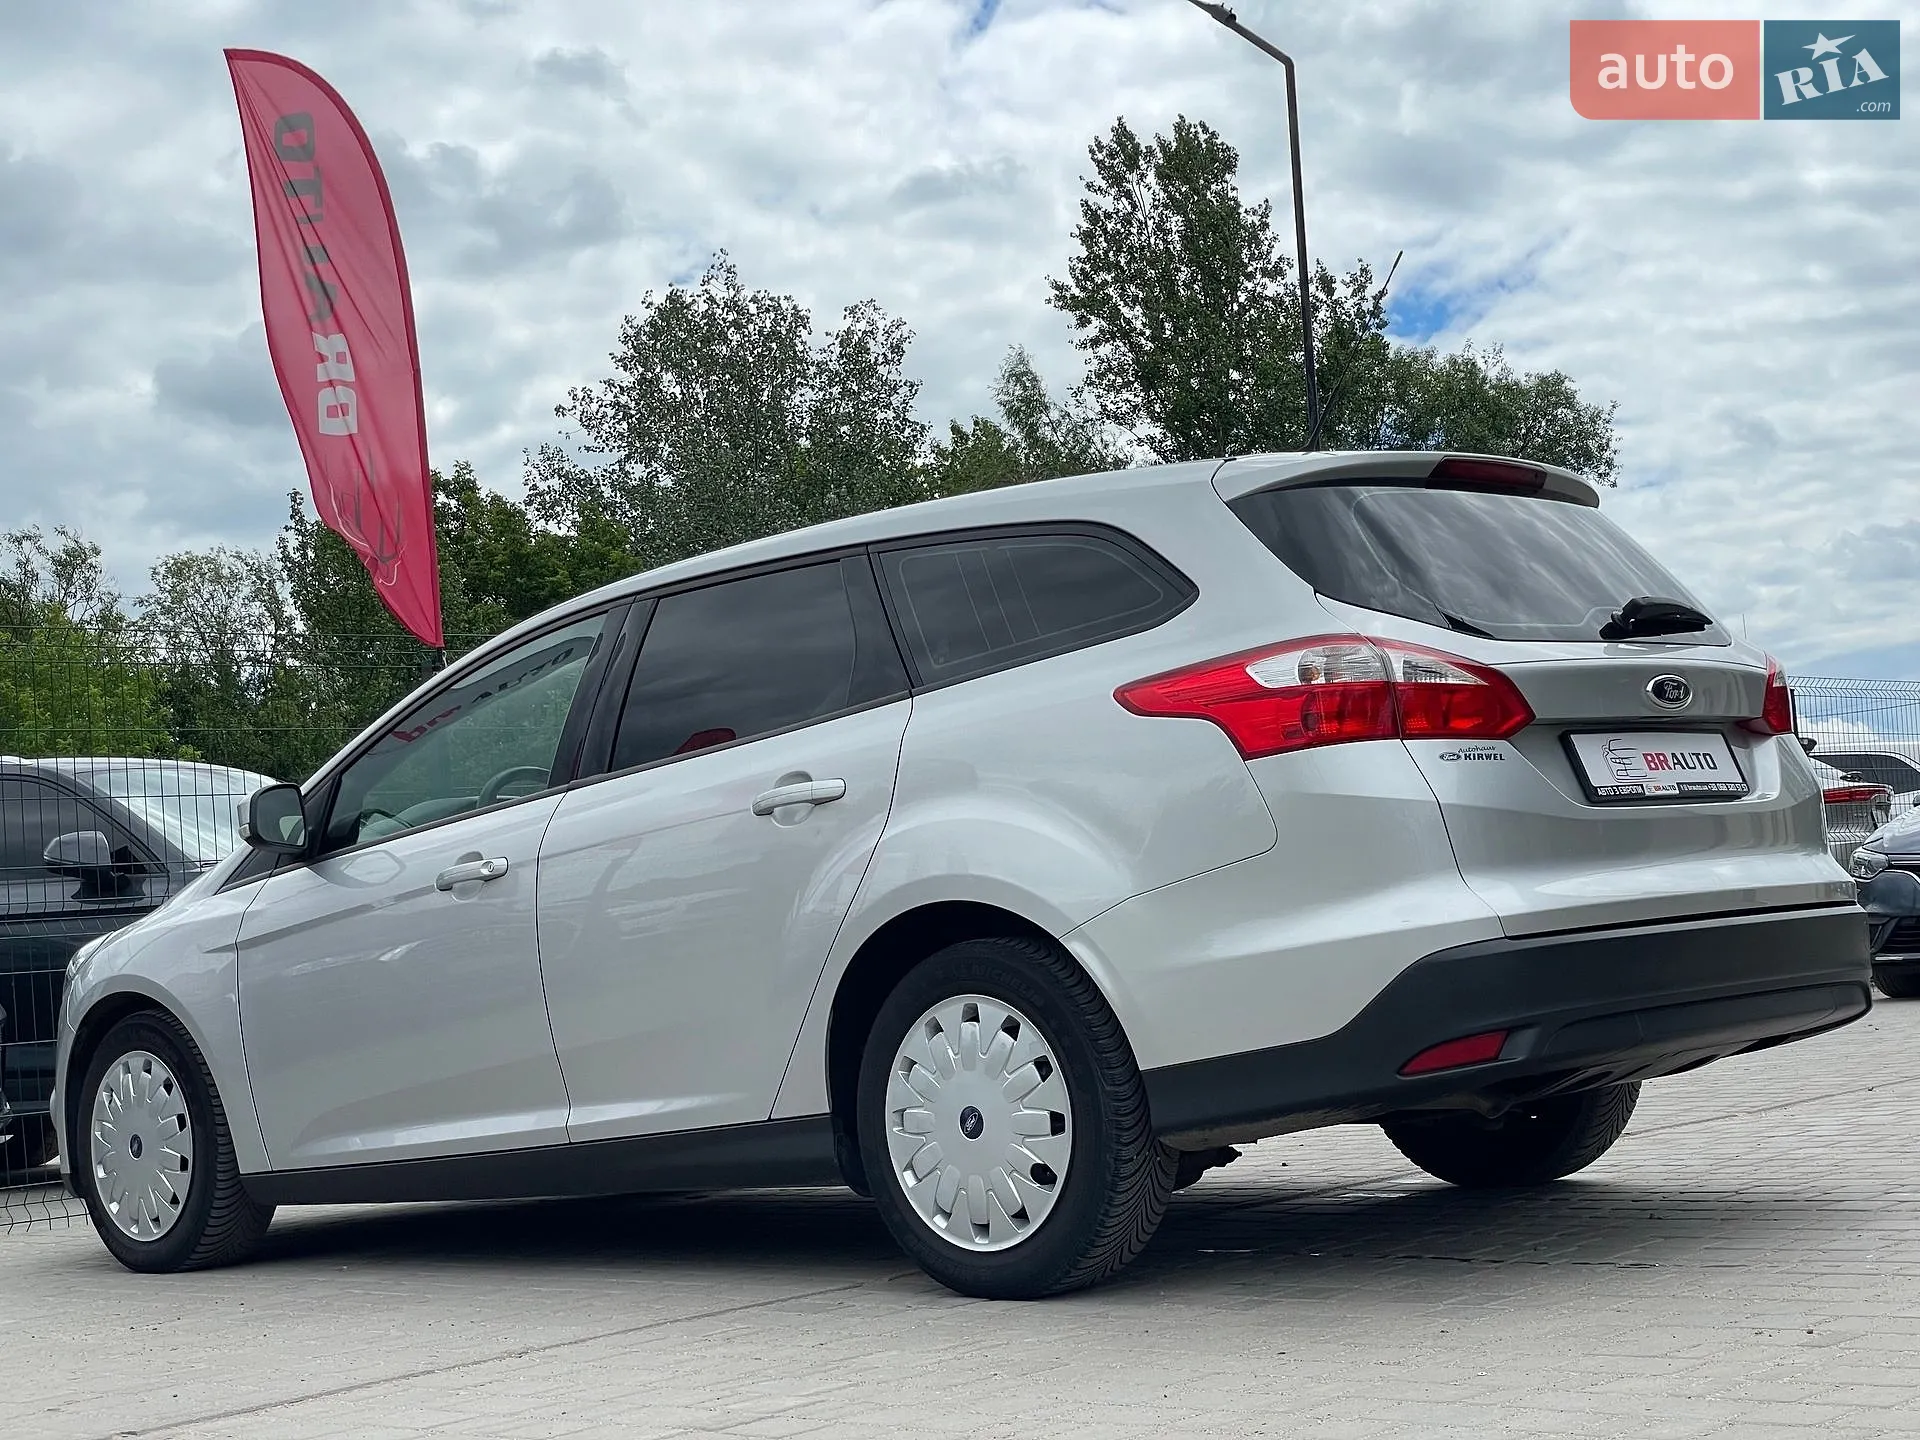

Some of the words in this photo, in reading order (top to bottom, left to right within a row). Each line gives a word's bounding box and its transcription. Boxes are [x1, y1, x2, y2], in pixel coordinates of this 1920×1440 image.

[1458, 745, 1497, 753] Autohaus
[1463, 753, 1506, 761] KIRWEL
[1641, 752, 1718, 771] BRAUTO
